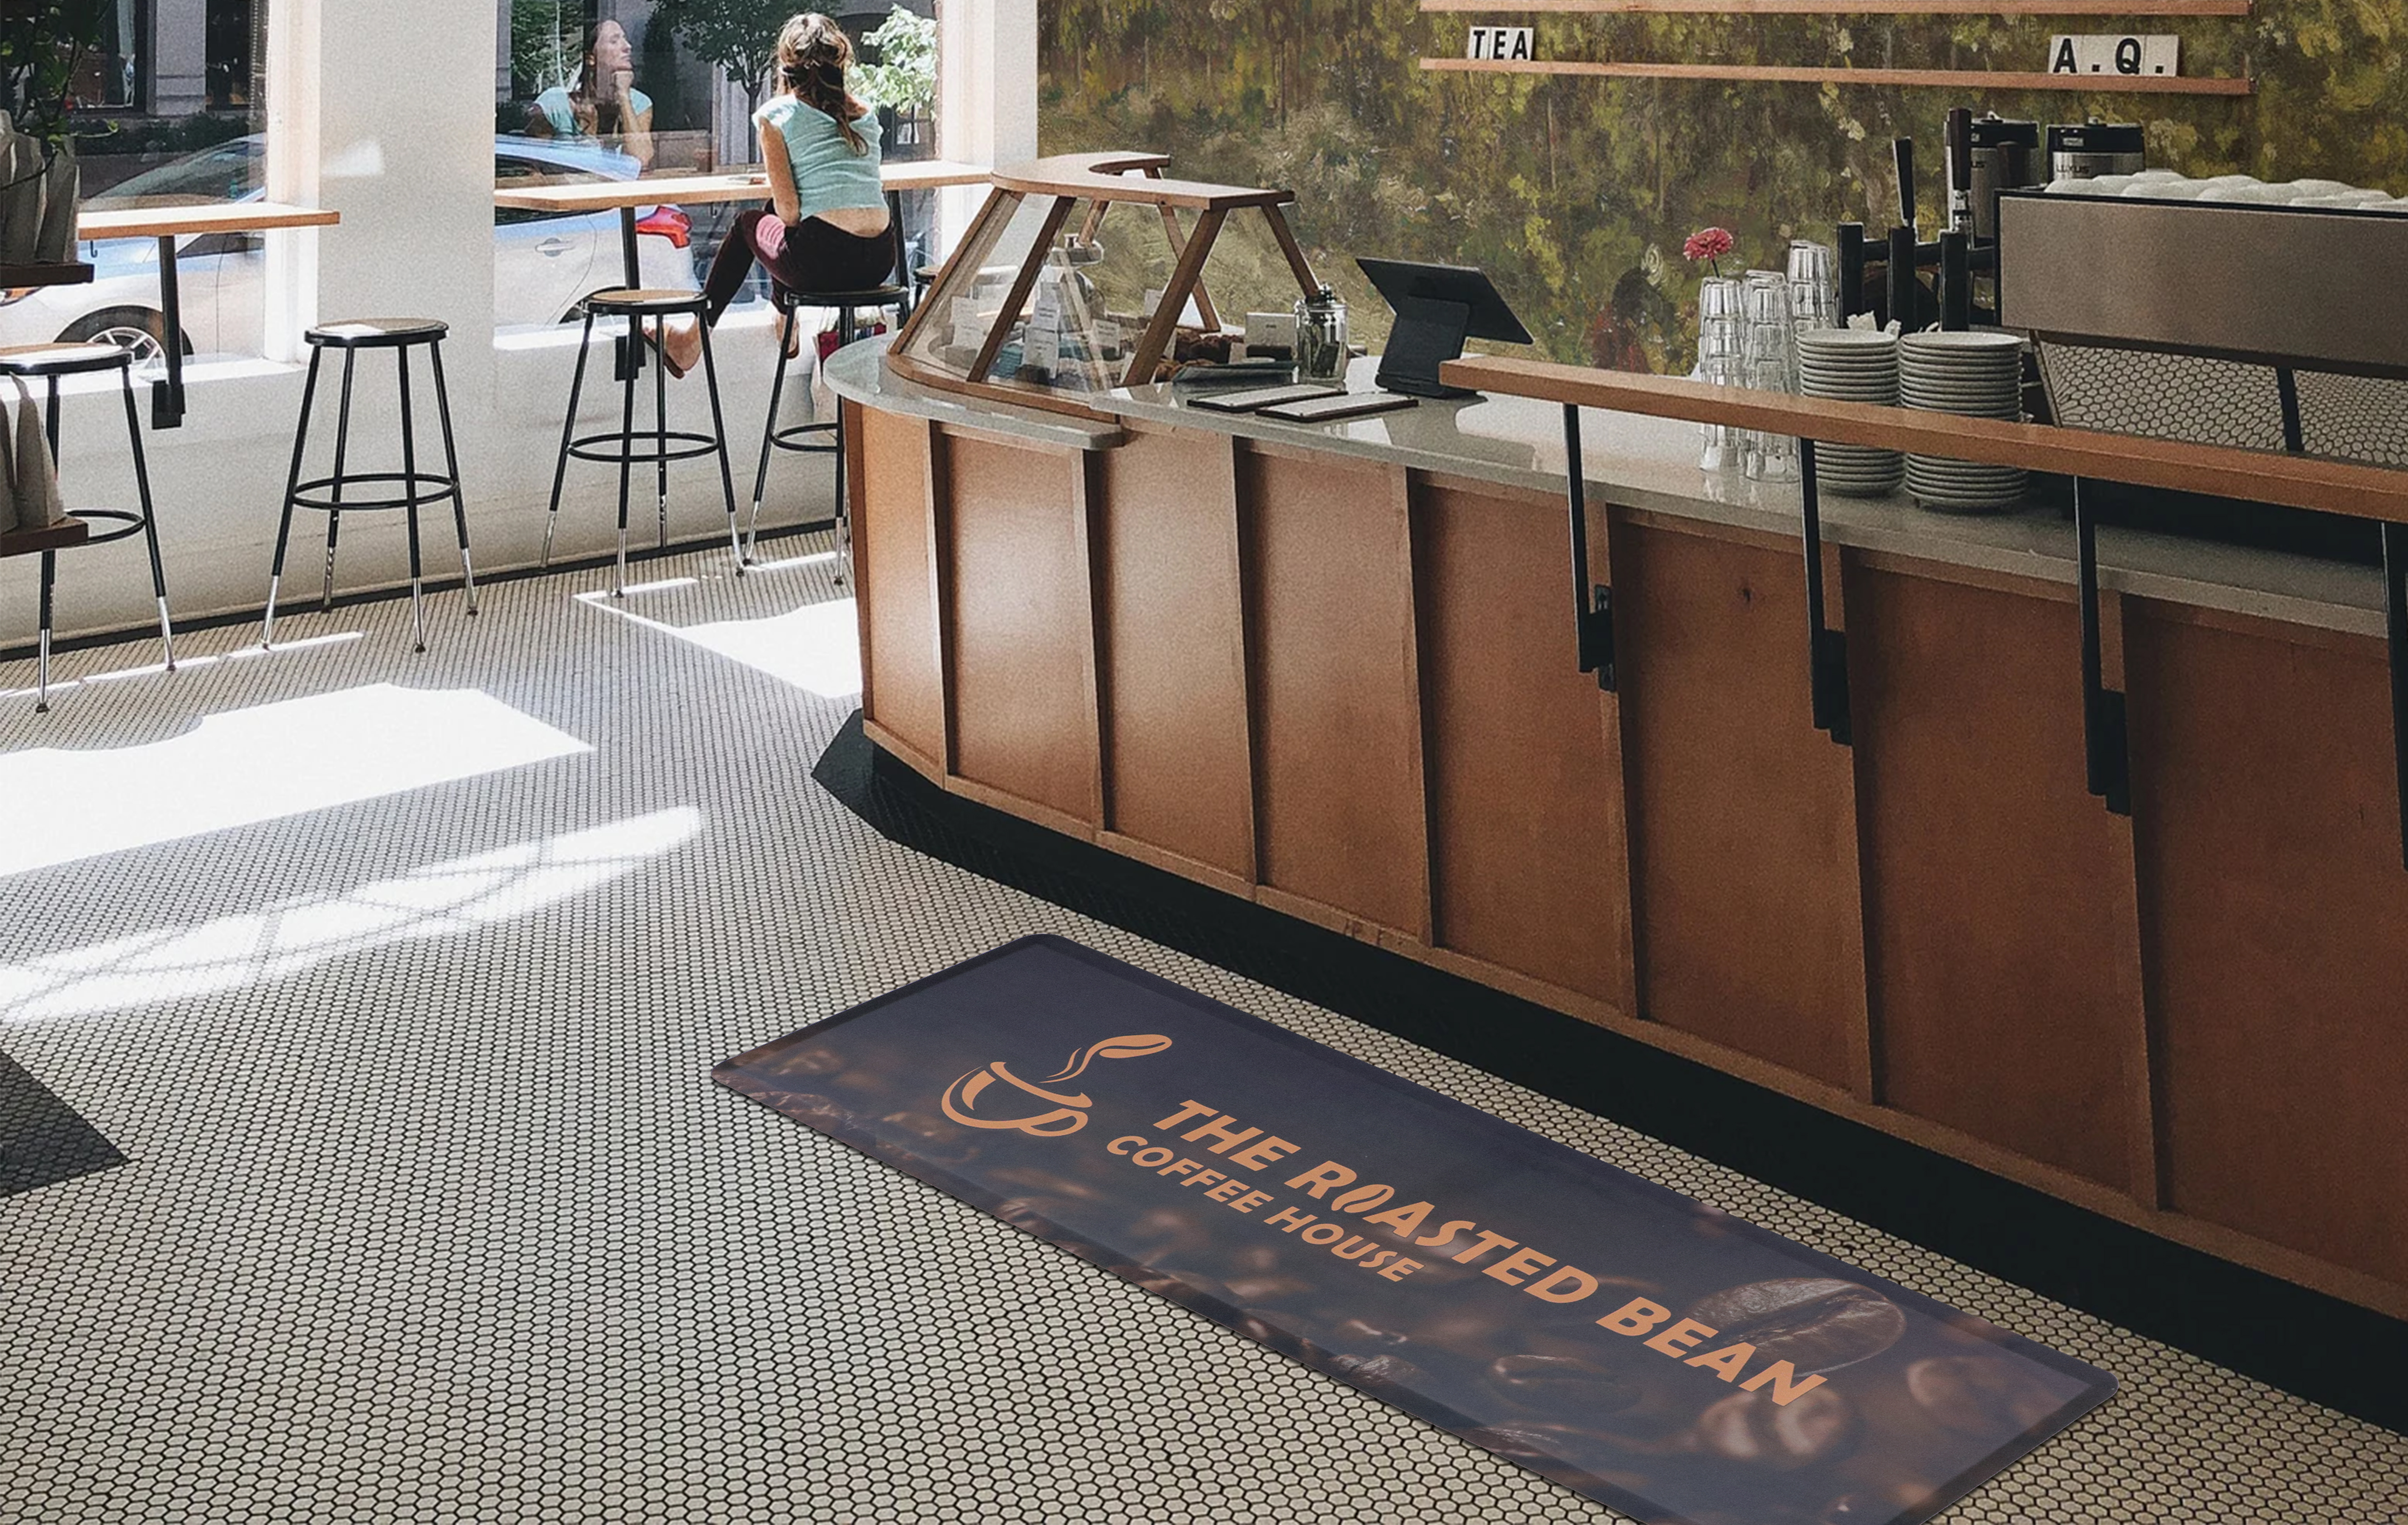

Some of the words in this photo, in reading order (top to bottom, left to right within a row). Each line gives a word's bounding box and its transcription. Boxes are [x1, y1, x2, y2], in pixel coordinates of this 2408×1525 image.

[1473, 30, 1528, 59] TEA
[1107, 1136, 1274, 1213] COFFEE
[1264, 1206, 1424, 1282] HOUSE
[1153, 1099, 1301, 1171] THE
[1284, 1160, 1598, 1303] ROASTED
[1596, 1297, 1827, 1406] BEAN
